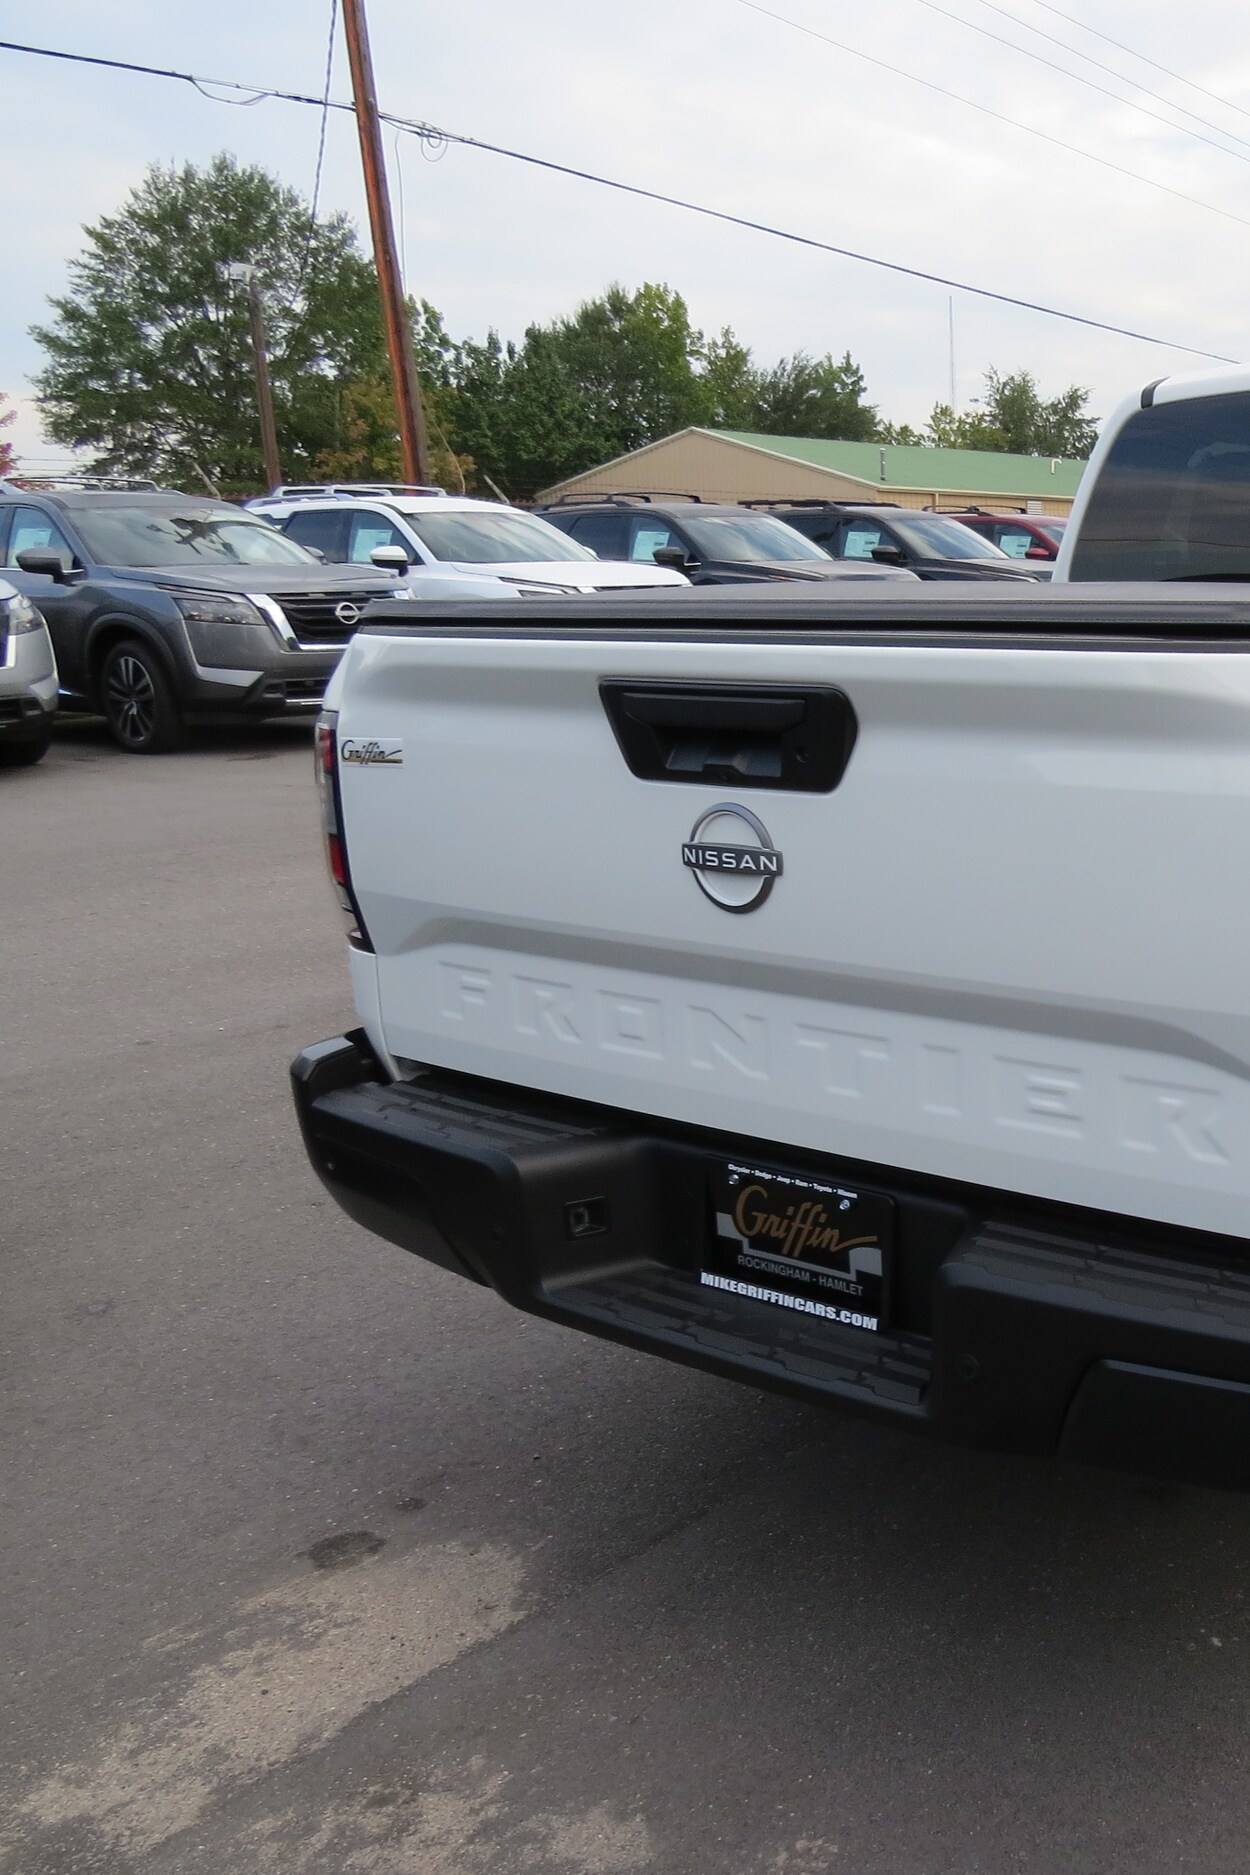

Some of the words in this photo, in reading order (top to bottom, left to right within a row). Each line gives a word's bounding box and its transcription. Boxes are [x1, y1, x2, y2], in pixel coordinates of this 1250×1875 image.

[341, 739, 403, 765] Griffin
[683, 847, 778, 872] NISSAN
[437, 960, 1232, 1167] FRONTIER
[734, 1184, 878, 1258] Griffin
[700, 1271, 878, 1332] MIKEGRIFFINCARS.COM
[737, 1254, 811, 1283] ROCKINGHAM
[818, 1275, 863, 1297] HAMLET
